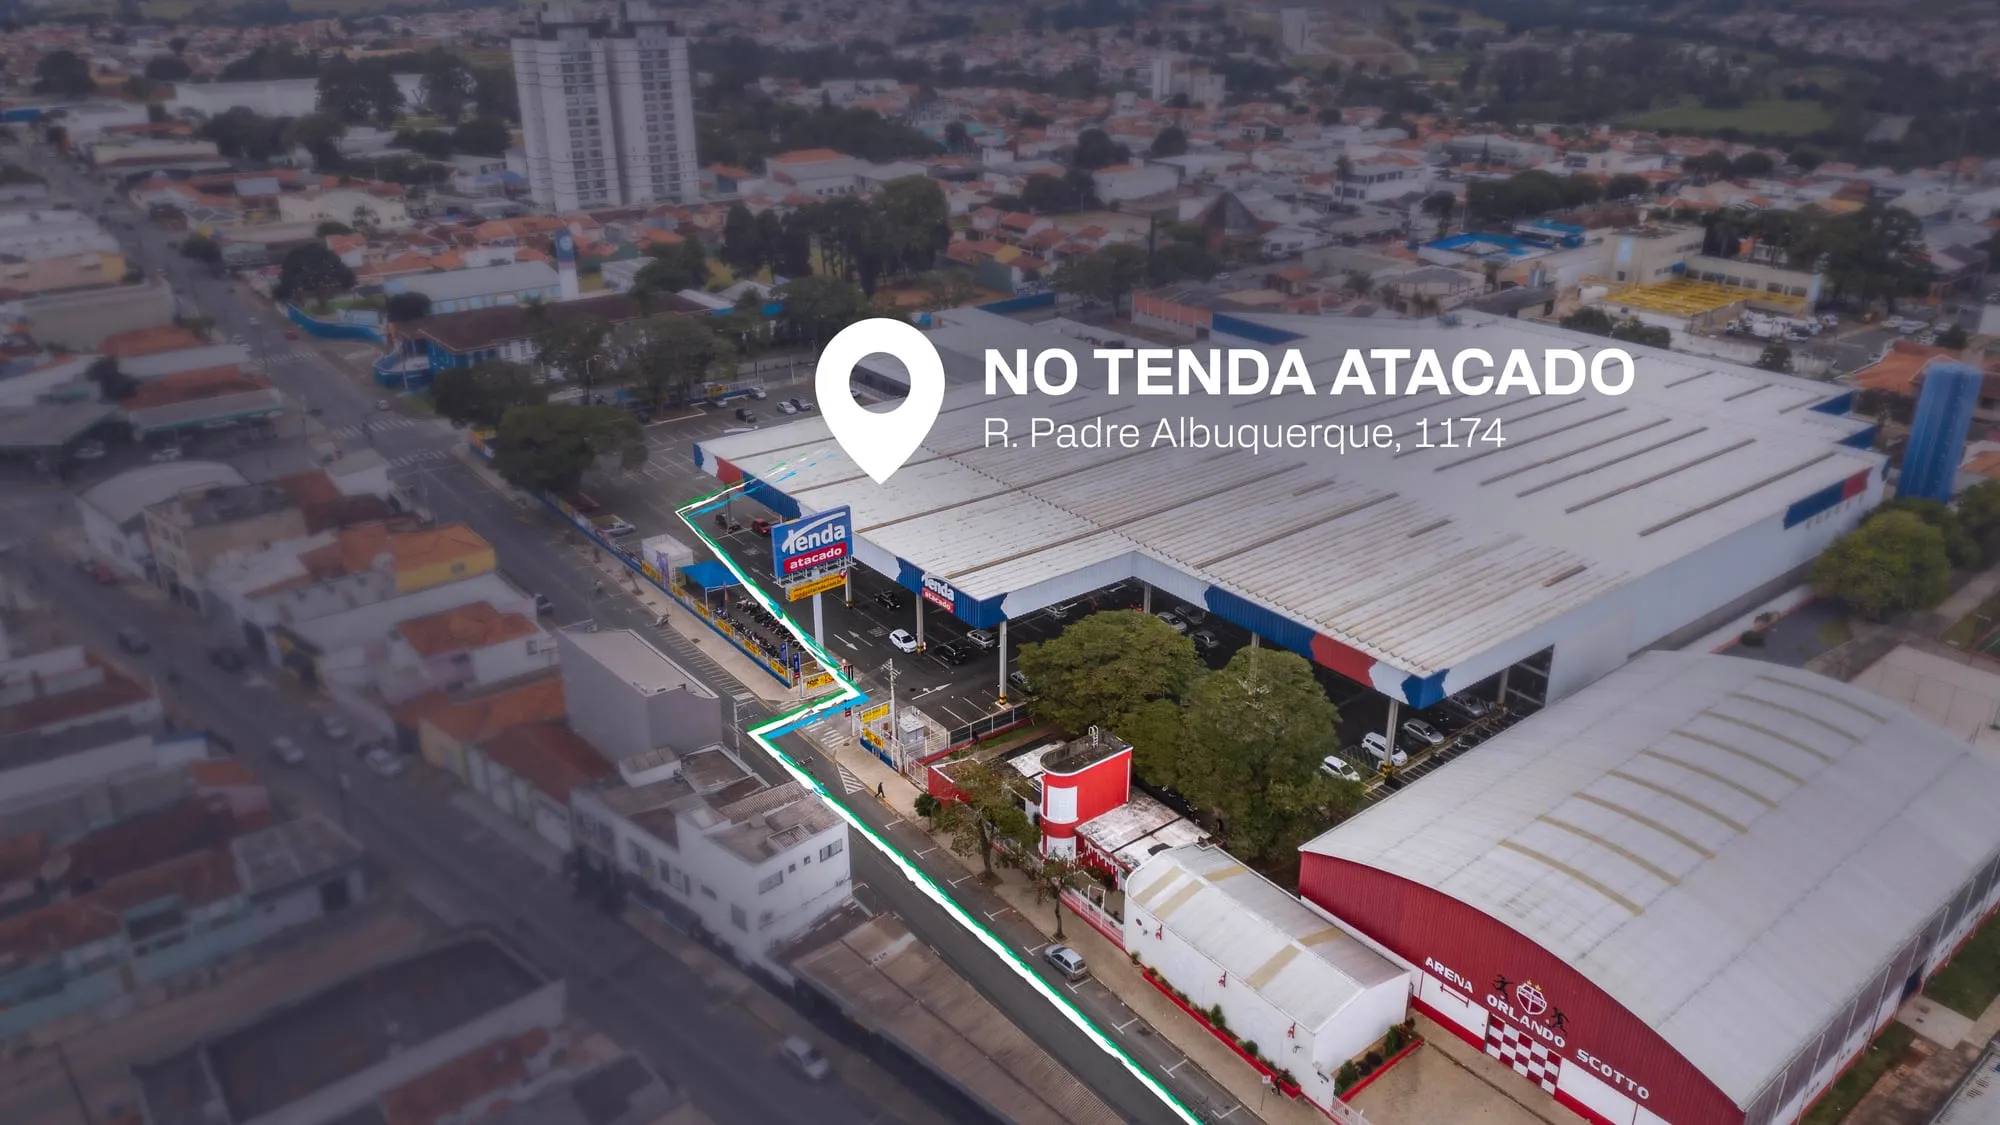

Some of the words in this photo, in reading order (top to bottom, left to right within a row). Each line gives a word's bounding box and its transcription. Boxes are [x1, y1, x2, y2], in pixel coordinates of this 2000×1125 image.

[789, 547, 843, 570] atacado
[1425, 956, 1474, 994] ARENA
[1486, 994, 1566, 1048] ORLANDO
[1576, 1048, 1650, 1100] SCOTTO
